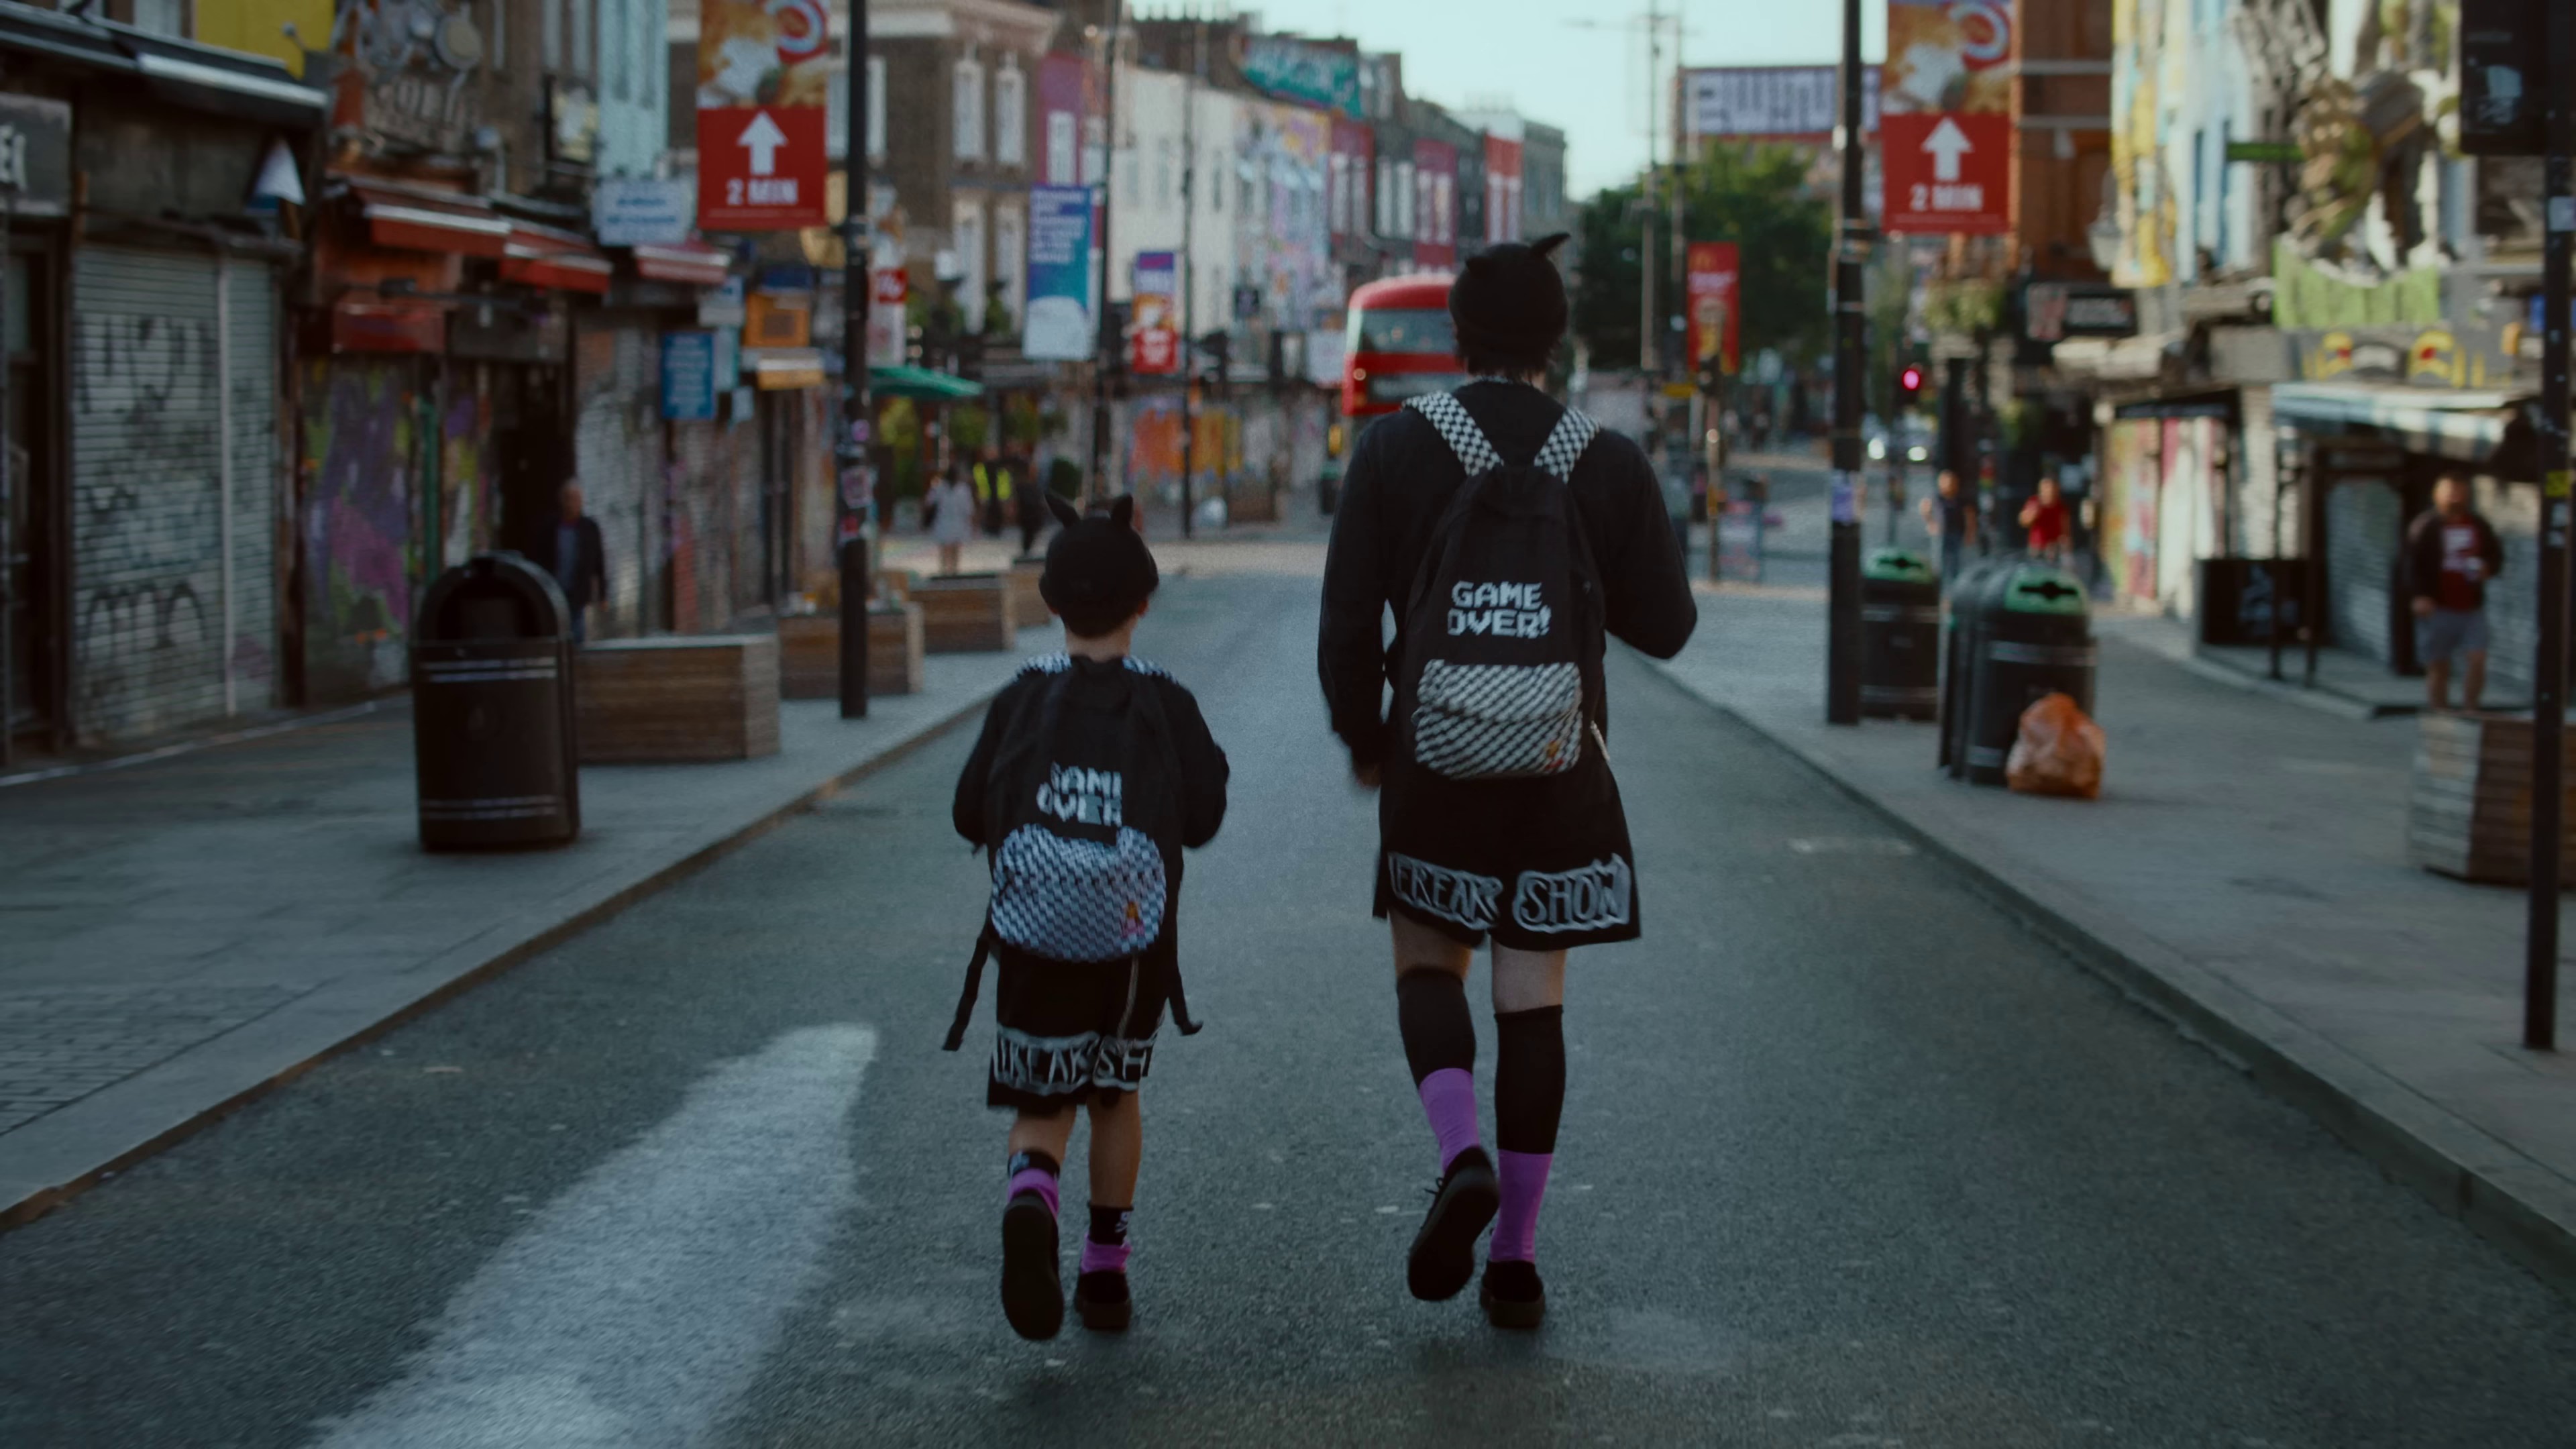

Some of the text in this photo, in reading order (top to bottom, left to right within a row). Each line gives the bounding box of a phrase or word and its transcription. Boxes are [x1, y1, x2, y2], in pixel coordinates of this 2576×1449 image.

[727, 177, 798, 205] 2 MIN
[1911, 182, 1983, 211] 2 MIN
[1452, 580, 1542, 610] GAME
[1448, 605, 1551, 639] OVER!
[1514, 857, 1630, 930] SHOW
